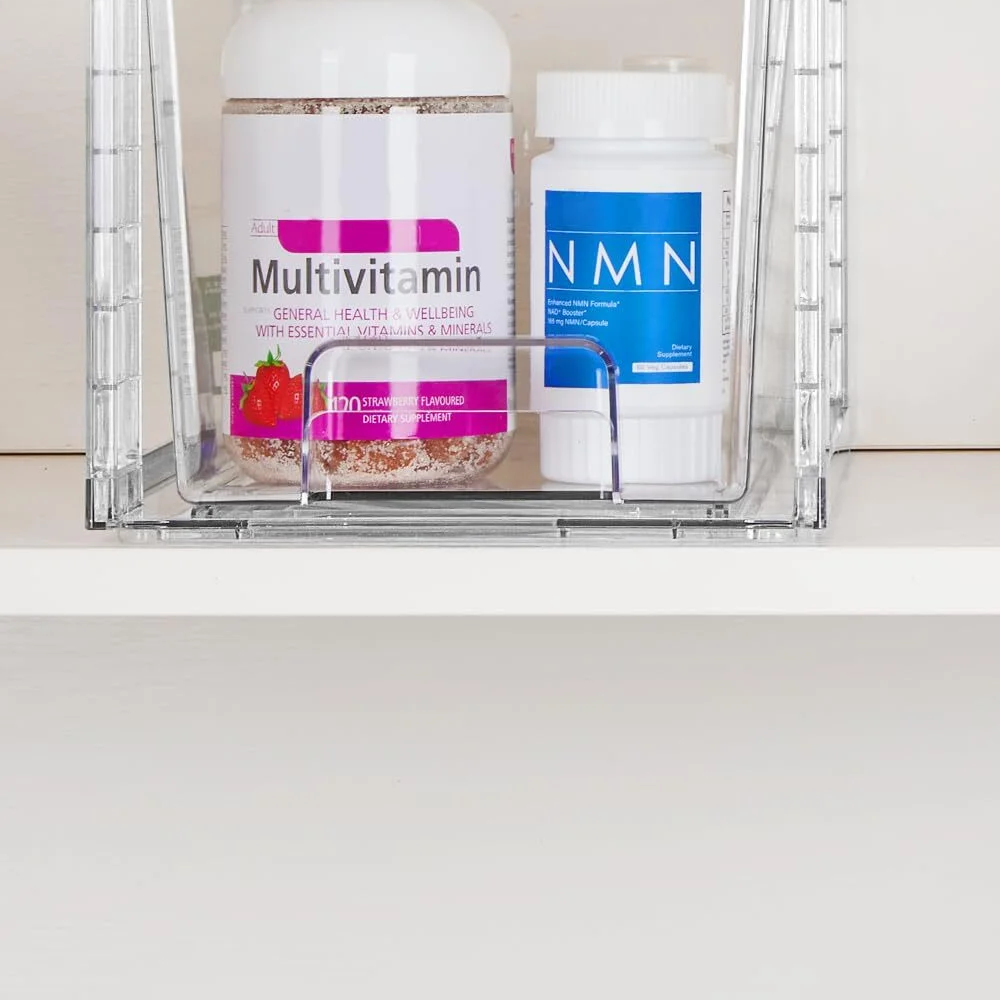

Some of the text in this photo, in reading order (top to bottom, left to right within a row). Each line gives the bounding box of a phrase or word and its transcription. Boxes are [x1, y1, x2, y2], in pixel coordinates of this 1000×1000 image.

[250, 223, 275, 234] Adult
[548, 239, 696, 286] NMN
[252, 257, 481, 295] Multivitamin
[273, 308, 330, 320] GENERAL
[335, 307, 388, 320] HEALTH
[406, 305, 474, 320] WELLBEING
[255, 322, 492, 338] WITH ESSENTIAL VITAMINS & MINERALS
[362, 396, 418, 407] STRAWBERRY
[420, 395, 465, 407] FLAVOURED
[362, 411, 452, 424] DIETARY SUPPLEMENT
